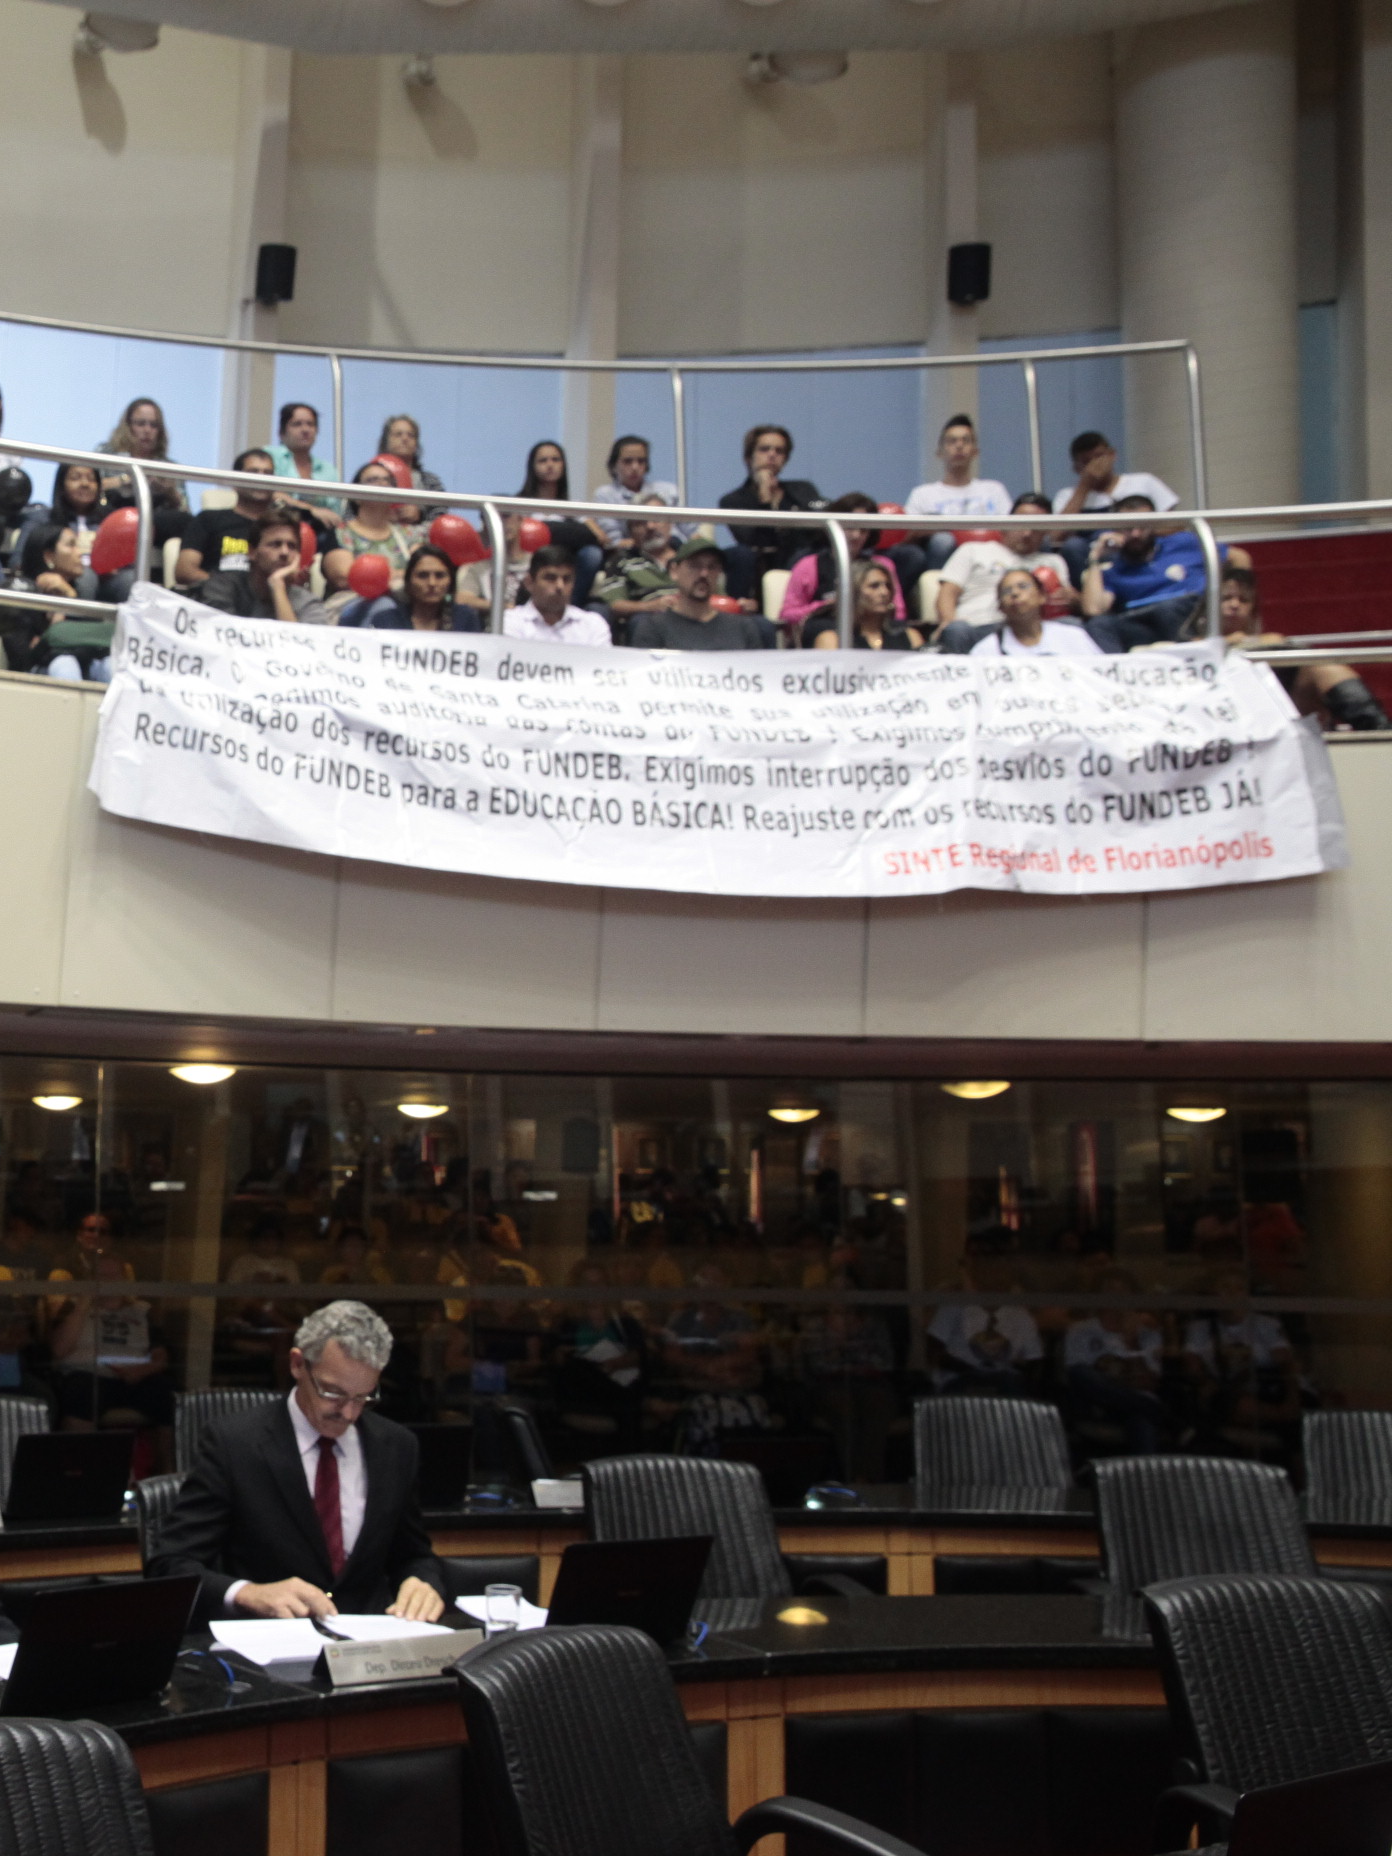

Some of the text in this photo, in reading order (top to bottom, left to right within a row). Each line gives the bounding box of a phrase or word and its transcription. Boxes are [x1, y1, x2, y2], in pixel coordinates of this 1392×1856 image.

[174, 607, 199, 638] Os
[333, 638, 362, 662] do
[381, 644, 479, 678] FUNDEB
[498, 652, 575, 685] devem
[593, 667, 628, 688] ser
[649, 664, 764, 694] utilizados
[782, 664, 969, 695] exclusivamente
[134, 712, 250, 764] Recursos
[256, 746, 285, 776] do
[294, 752, 392, 799] FUNDEB
[401, 782, 457, 811] para
[466, 788, 479, 812] a
[489, 786, 623, 829] EDUCAÇÃO
[631, 789, 735, 830] BÁSICA!
[743, 803, 856, 838] Reajuste
[924, 803, 954, 826] os
[963, 797, 1056, 826] recursos
[1065, 796, 1093, 825] do
[1103, 786, 1212, 823] FUNDEB
[1221, 768, 1264, 811] JÁ!
[311, 711, 351, 747] dos
[364, 729, 471, 765] recursos
[482, 743, 510, 771] do
[645, 754, 755, 791] Exigimos
[766, 757, 910, 793] interrupção
[923, 756, 970, 783] dos
[1079, 749, 1113, 779] do
[1128, 739, 1234, 777] FUNDEB
[884, 829, 1275, 876] SINTE Regional de Florianópolis
